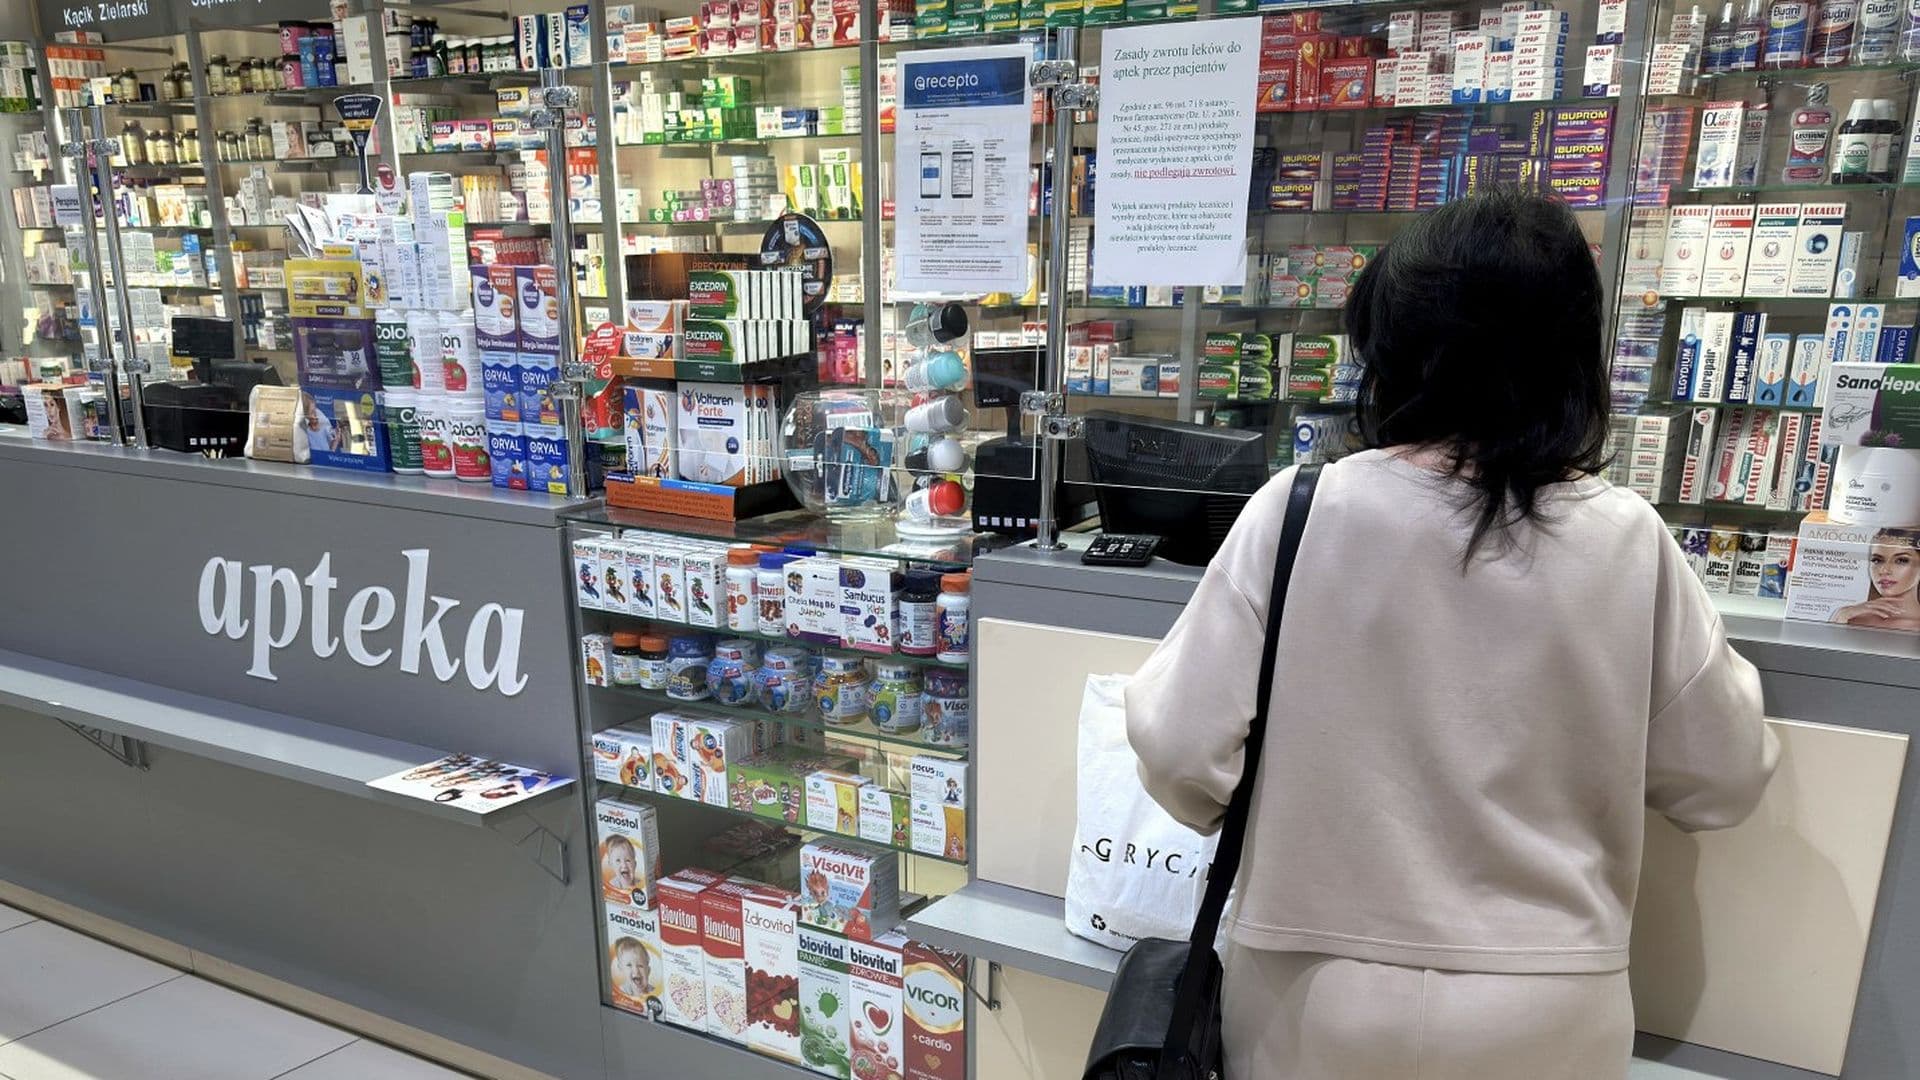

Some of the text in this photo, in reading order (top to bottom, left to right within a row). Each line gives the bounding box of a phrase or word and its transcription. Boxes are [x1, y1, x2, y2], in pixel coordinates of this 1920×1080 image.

[64, 0, 149, 27] Kącik Zielarski
[1503, 5, 1525, 13] APAP
[1866, 3, 1897, 14] Eludril
[1392, 13, 1412, 21] APAP
[1481, 17, 1501, 26] APA
[1114, 41, 1241, 61] Zasady zwrotu leków do
[1458, 41, 1483, 51] APAP
[1520, 47, 1537, 55] APAP
[1491, 53, 1513, 63] APAP
[1588, 48, 1612, 57] APAP
[1113, 61, 1227, 80] aptek przez pacjentów
[1558, 110, 1608, 121] IBUPROM
[1554, 145, 1604, 153] IBUPROM
[1283, 154, 1320, 163] IBUPROM
[1135, 168, 1148, 178] nie
[1150, 166, 1190, 180] podlegają
[1551, 178, 1600, 187] IBUPROM
[1272, 184, 1313, 193] IBUPROM
[1673, 208, 1710, 216] LACALUT
[1715, 208, 1752, 216] LACALUT
[1759, 207, 1797, 215] LACALUT
[1803, 207, 1843, 215] LACALUT
[690, 282, 728, 291] EXCEDRIN
[375, 324, 406, 340] Colo
[685, 331, 723, 341] EXCEDRIN
[1206, 339, 1237, 347] EXCEDRIN
[1295, 341, 1330, 349] EXCEDRIN
[484, 369, 514, 383] ORYAL
[1200, 372, 1232, 380] EXCEDRIN
[1676, 348, 1693, 396] ELGYDIUM
[1700, 348, 1718, 398] Biorepair
[1729, 350, 1751, 400] Biorepair
[1290, 374, 1324, 382] EXCEDRIN
[696, 391, 734, 407] Voltaren
[698, 405, 723, 417] Forte
[1785, 415, 1799, 455] LACALUT
[1807, 414, 1822, 460] LACALUT
[491, 438, 522, 452] ORYAL
[529, 442, 561, 455] ORYAL
[1681, 457, 1696, 501] LACALUT
[1746, 458, 1763, 502] LACALUT
[1812, 464, 1829, 509] LACALUT
[1708, 561, 1729, 570] Ultra
[1739, 561, 1760, 570] Ultra
[1706, 568, 1730, 577] Blanc
[1736, 568, 1760, 577] Blanc
[844, 589, 885, 604] Sambucus
[808, 599, 824, 609] Mag
[866, 604, 885, 615] Kids
[198, 548, 529, 696] apteka
[944, 701, 969, 710] Viso
[912, 763, 935, 774] FOCUS
[598, 814, 639, 830] sanostol
[811, 855, 865, 880] VisolVit
[661, 903, 698, 929] Bioviton
[744, 908, 794, 935] Zdrovital
[609, 912, 656, 933] sanostol
[704, 915, 741, 943] Bioviton
[800, 934, 844, 961] biovital
[850, 947, 897, 974] biovital
[906, 984, 960, 1012] VIGOR
